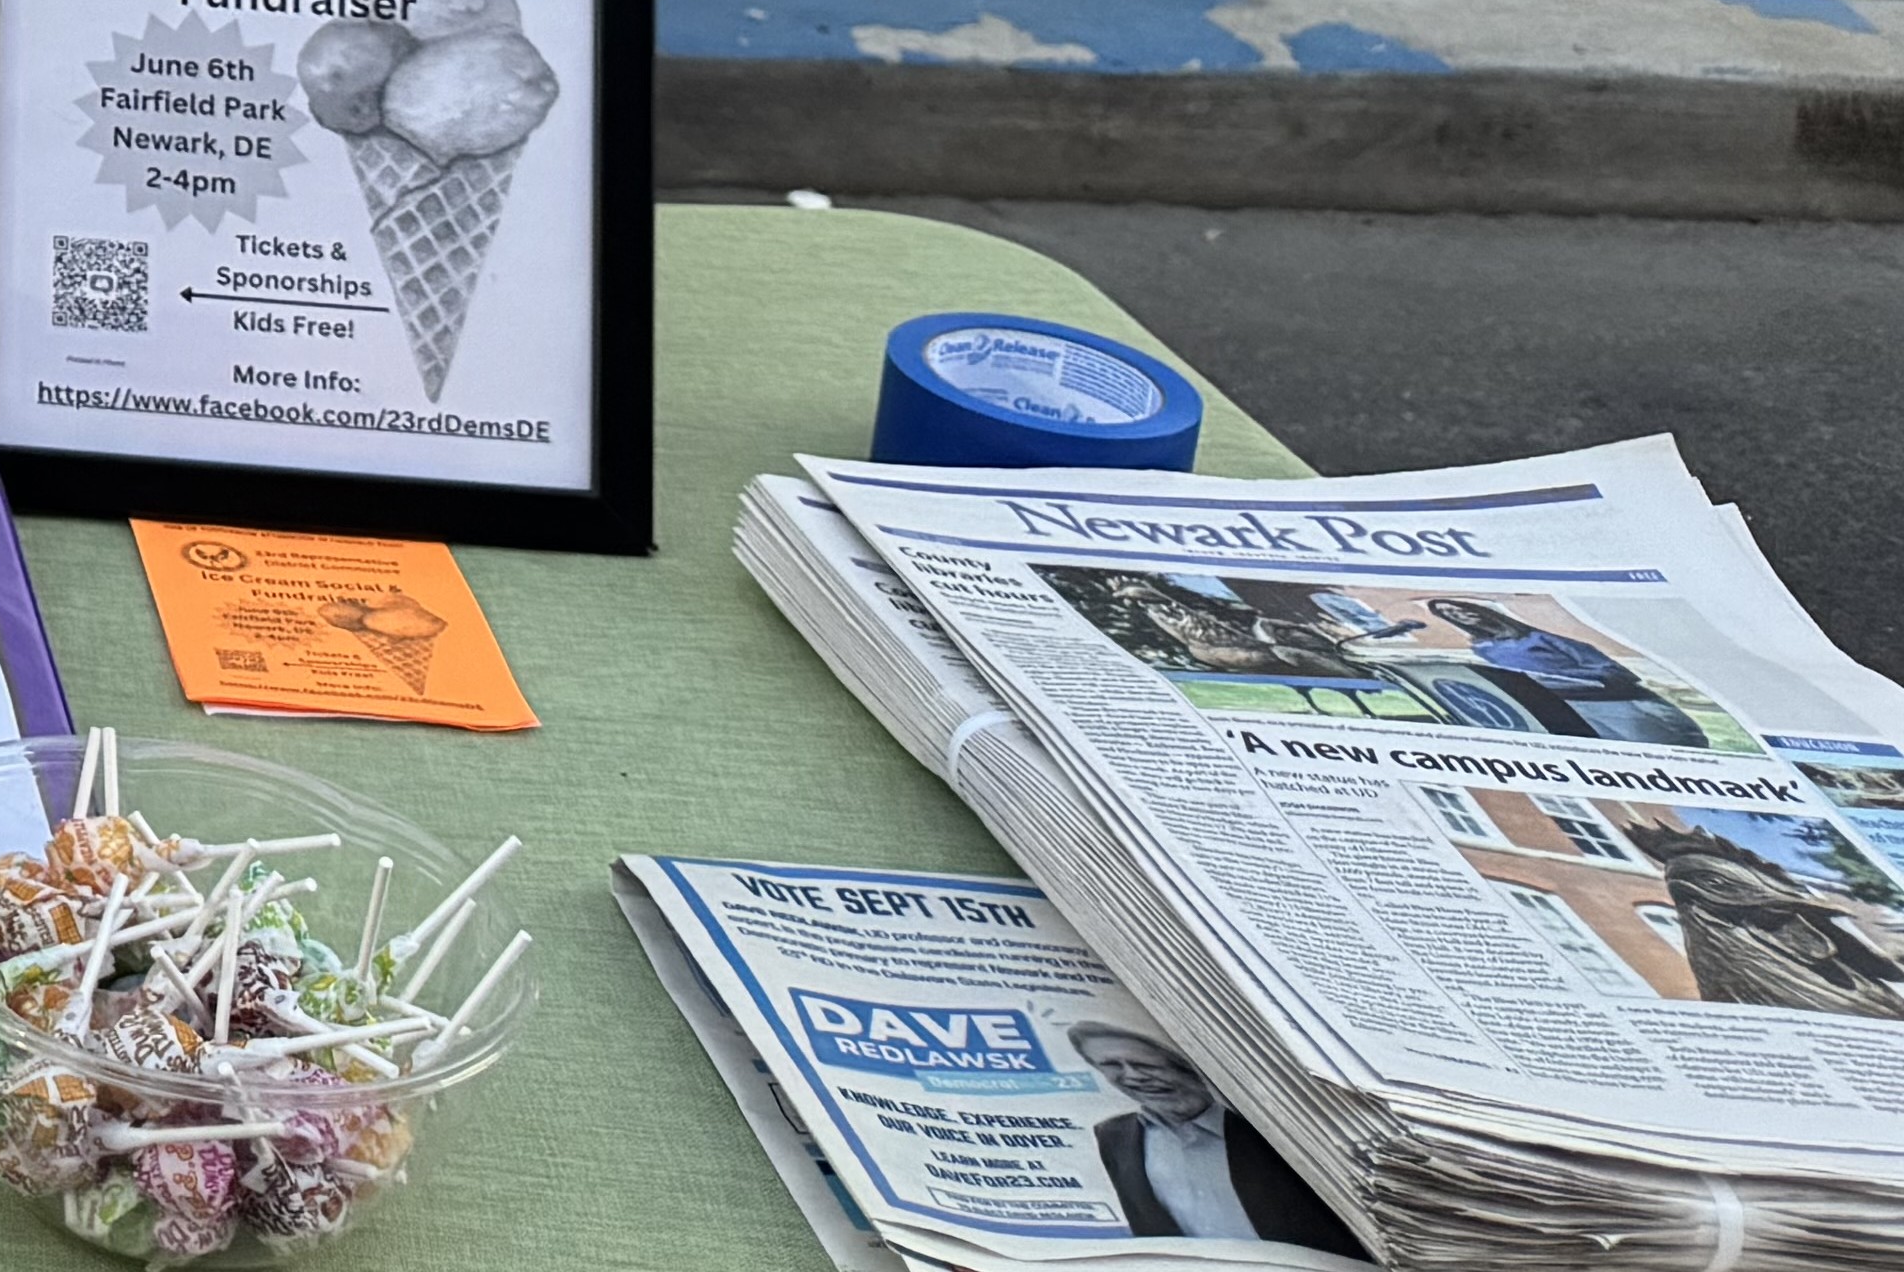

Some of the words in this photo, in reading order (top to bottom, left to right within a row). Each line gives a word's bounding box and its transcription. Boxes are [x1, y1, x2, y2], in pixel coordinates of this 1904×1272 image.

[131, 53, 199, 78] June
[207, 57, 254, 81] 6th
[100, 88, 215, 116] Fairfield
[224, 95, 286, 122] Park
[112, 127, 225, 159] Newark,
[233, 137, 272, 159] DE
[146, 168, 237, 196] 2-4pm
[236, 235, 323, 260] Tickets
[330, 242, 346, 261] &
[216, 267, 372, 298] Sponorships
[233, 312, 285, 334] Kids
[293, 316, 355, 340] Free!
[993, 338, 1062, 361] Release
[233, 366, 297, 389] More
[304, 371, 360, 394] Info:
[38, 382, 552, 442] https://www.facebook.com/23rdDemsDE
[1013, 397, 1062, 419] Clean
[996, 499, 1314, 555] Newark
[1305, 514, 1492, 559] Post
[899, 546, 991, 572] County
[912, 560, 1023, 587] libraries
[929, 579, 973, 595] cut
[974, 584, 1054, 604] hours
[1280, 739, 1378, 766] new
[1391, 746, 1576, 787] campus
[732, 873, 837, 913] VOTE
[838, 888, 936, 919] SEPT
[939, 896, 1036, 929] 15TH
[800, 990, 1032, 1051] DAVE
[839, 1038, 1036, 1070] REDLAWSK
